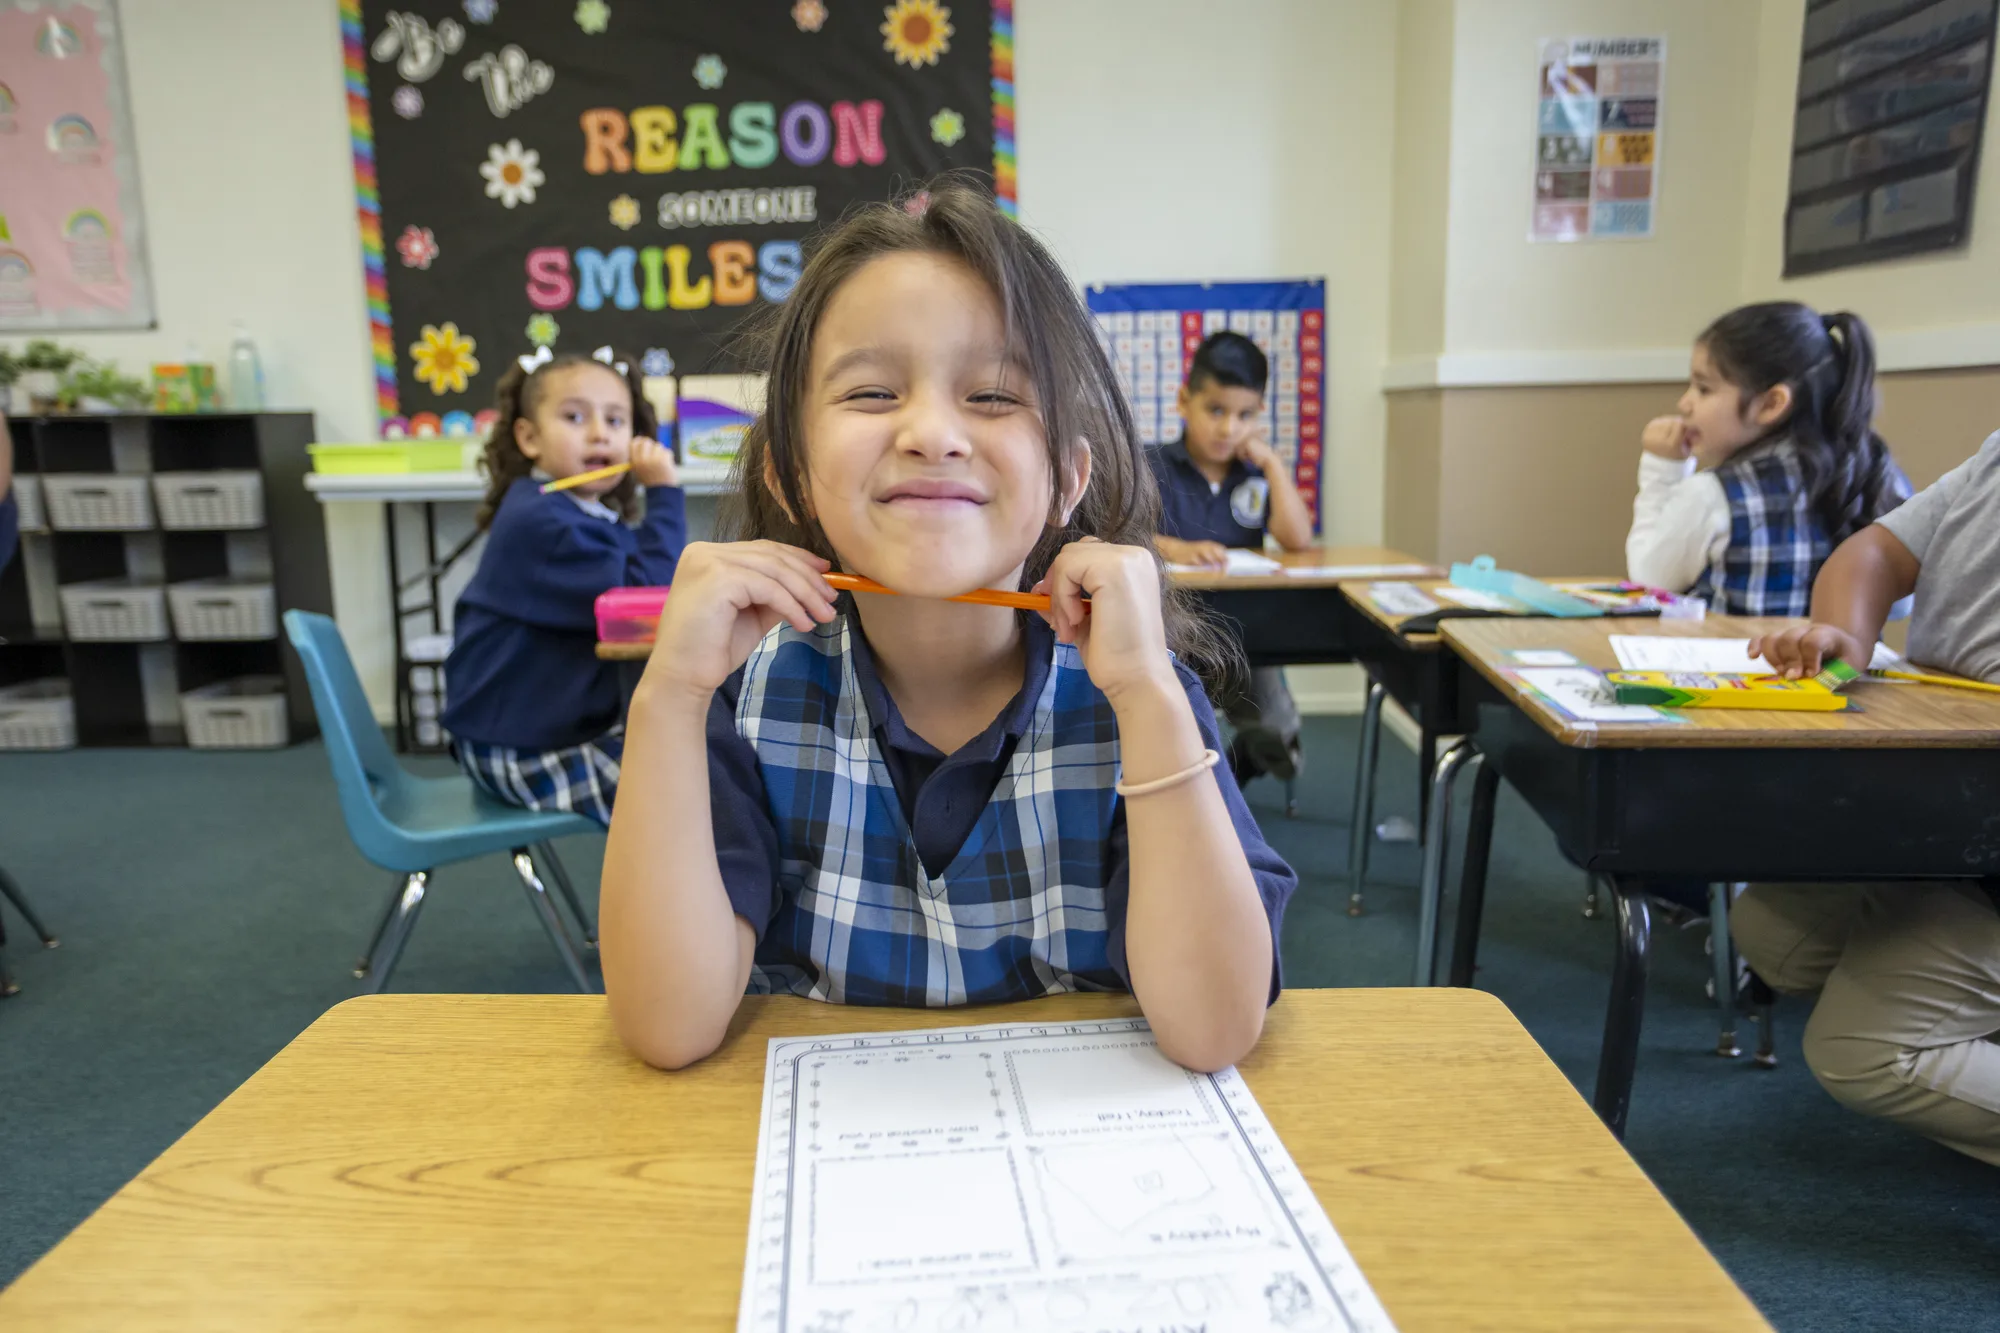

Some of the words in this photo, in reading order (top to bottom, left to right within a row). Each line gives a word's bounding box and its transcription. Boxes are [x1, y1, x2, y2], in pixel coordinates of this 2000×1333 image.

[371, 10, 466, 83] Be
[579, 99, 886, 175] REASON
[658, 185, 818, 229] SOMEONE
[525, 240, 803, 311] SMILES
